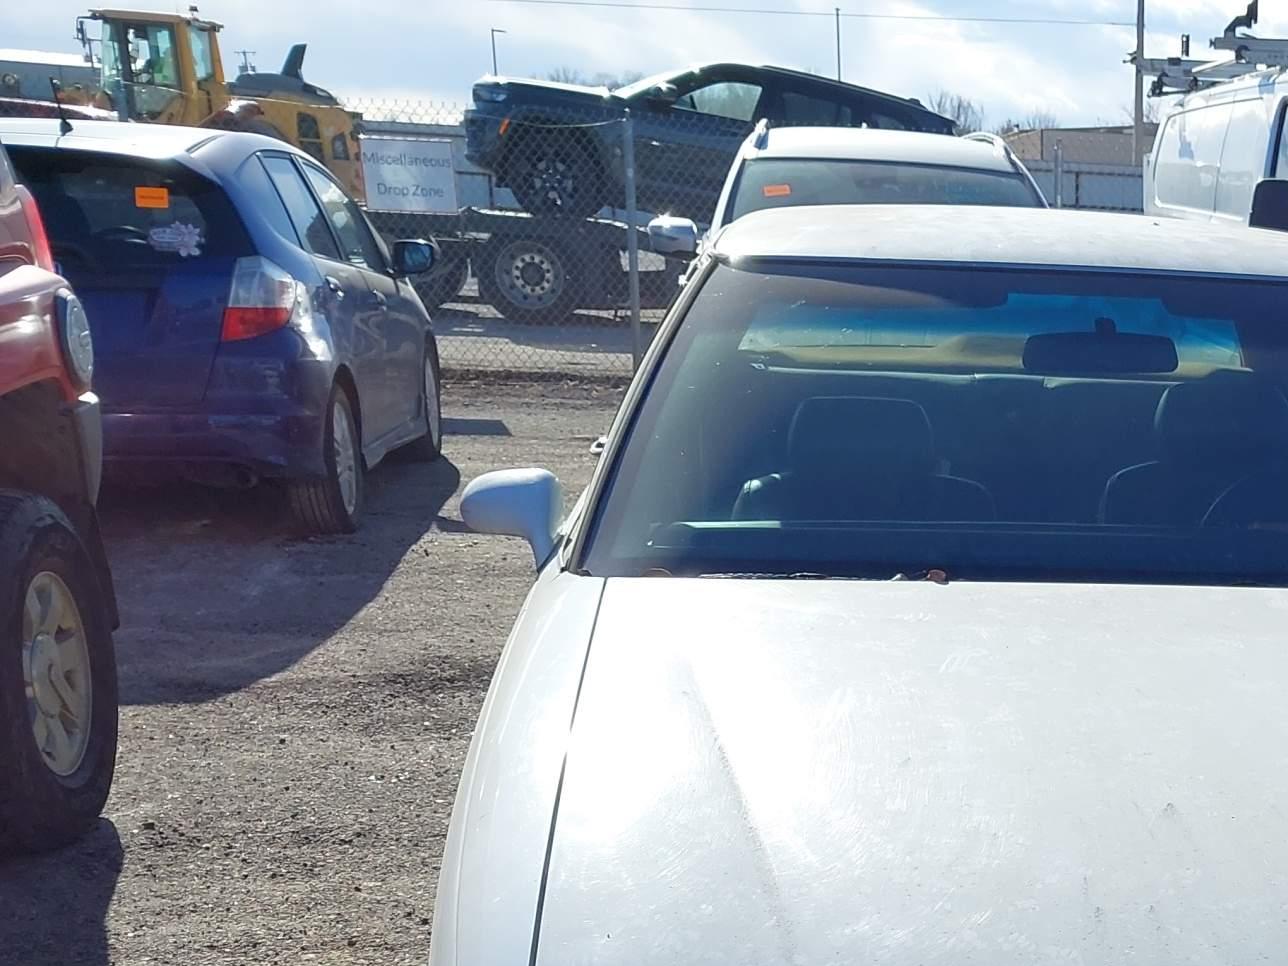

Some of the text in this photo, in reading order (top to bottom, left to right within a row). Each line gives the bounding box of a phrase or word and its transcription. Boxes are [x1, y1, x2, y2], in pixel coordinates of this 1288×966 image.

[363, 152, 451, 168] Miscellaneous
[377, 183, 445, 198] Drop Zone
